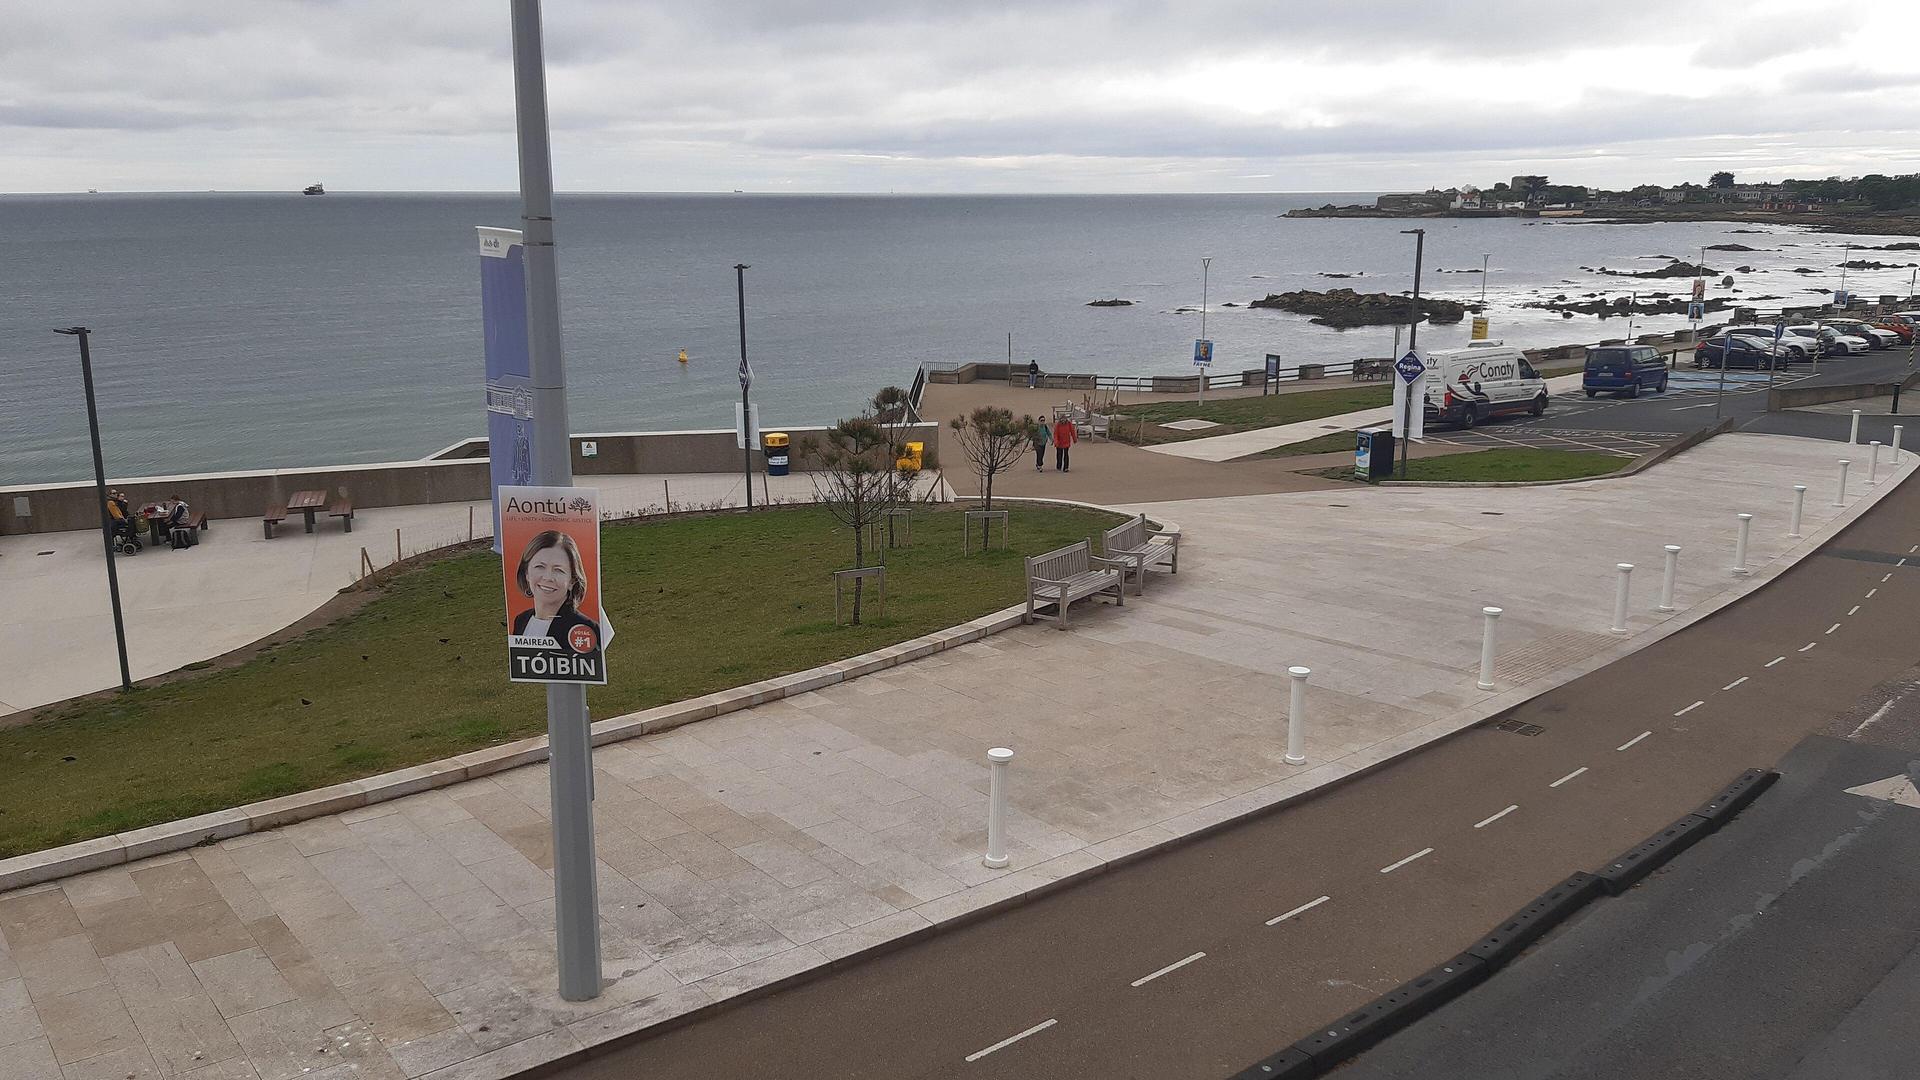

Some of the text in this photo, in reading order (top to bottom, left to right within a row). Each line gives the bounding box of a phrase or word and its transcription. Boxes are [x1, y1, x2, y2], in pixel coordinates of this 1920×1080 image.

[1399, 363, 1421, 371] Regina
[1480, 361, 1515, 379] Conaty
[506, 497, 566, 515] Aontú
[515, 638, 555, 647] MAIREAD
[574, 636, 591, 648] #1
[517, 652, 596, 676] TÓIBÍN
